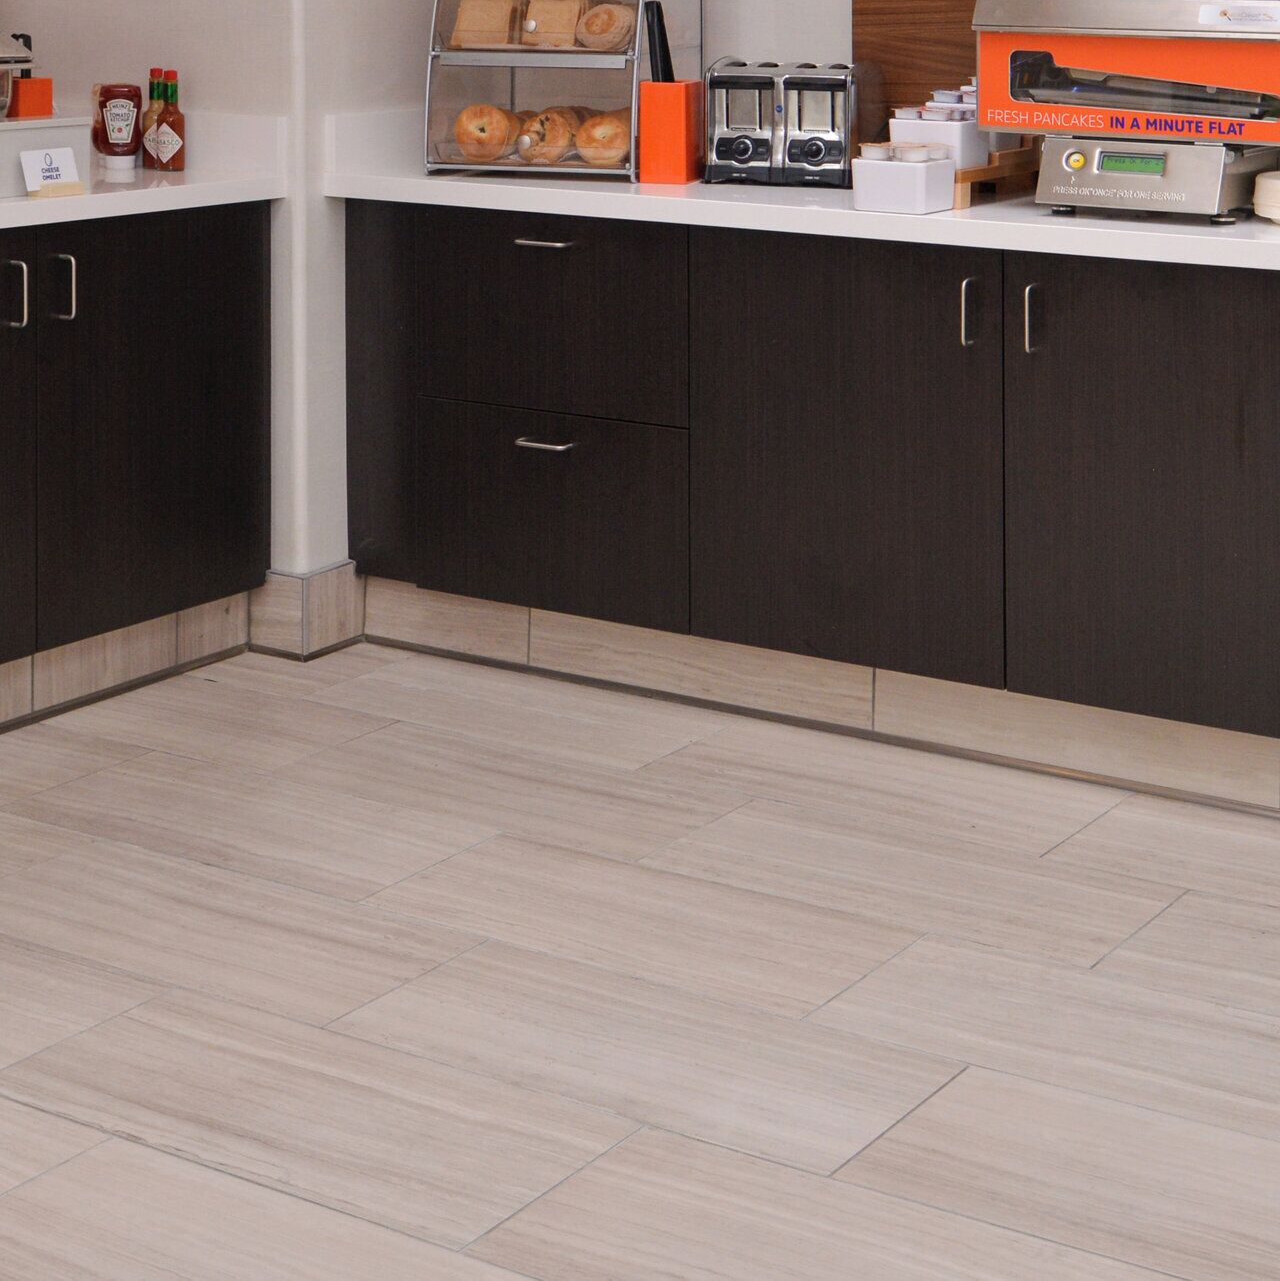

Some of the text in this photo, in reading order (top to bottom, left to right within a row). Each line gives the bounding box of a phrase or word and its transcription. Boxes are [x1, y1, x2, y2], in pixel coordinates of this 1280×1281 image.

[987, 109, 1246, 136] FRESH PANCAKES IN A MINUTE FLAT
